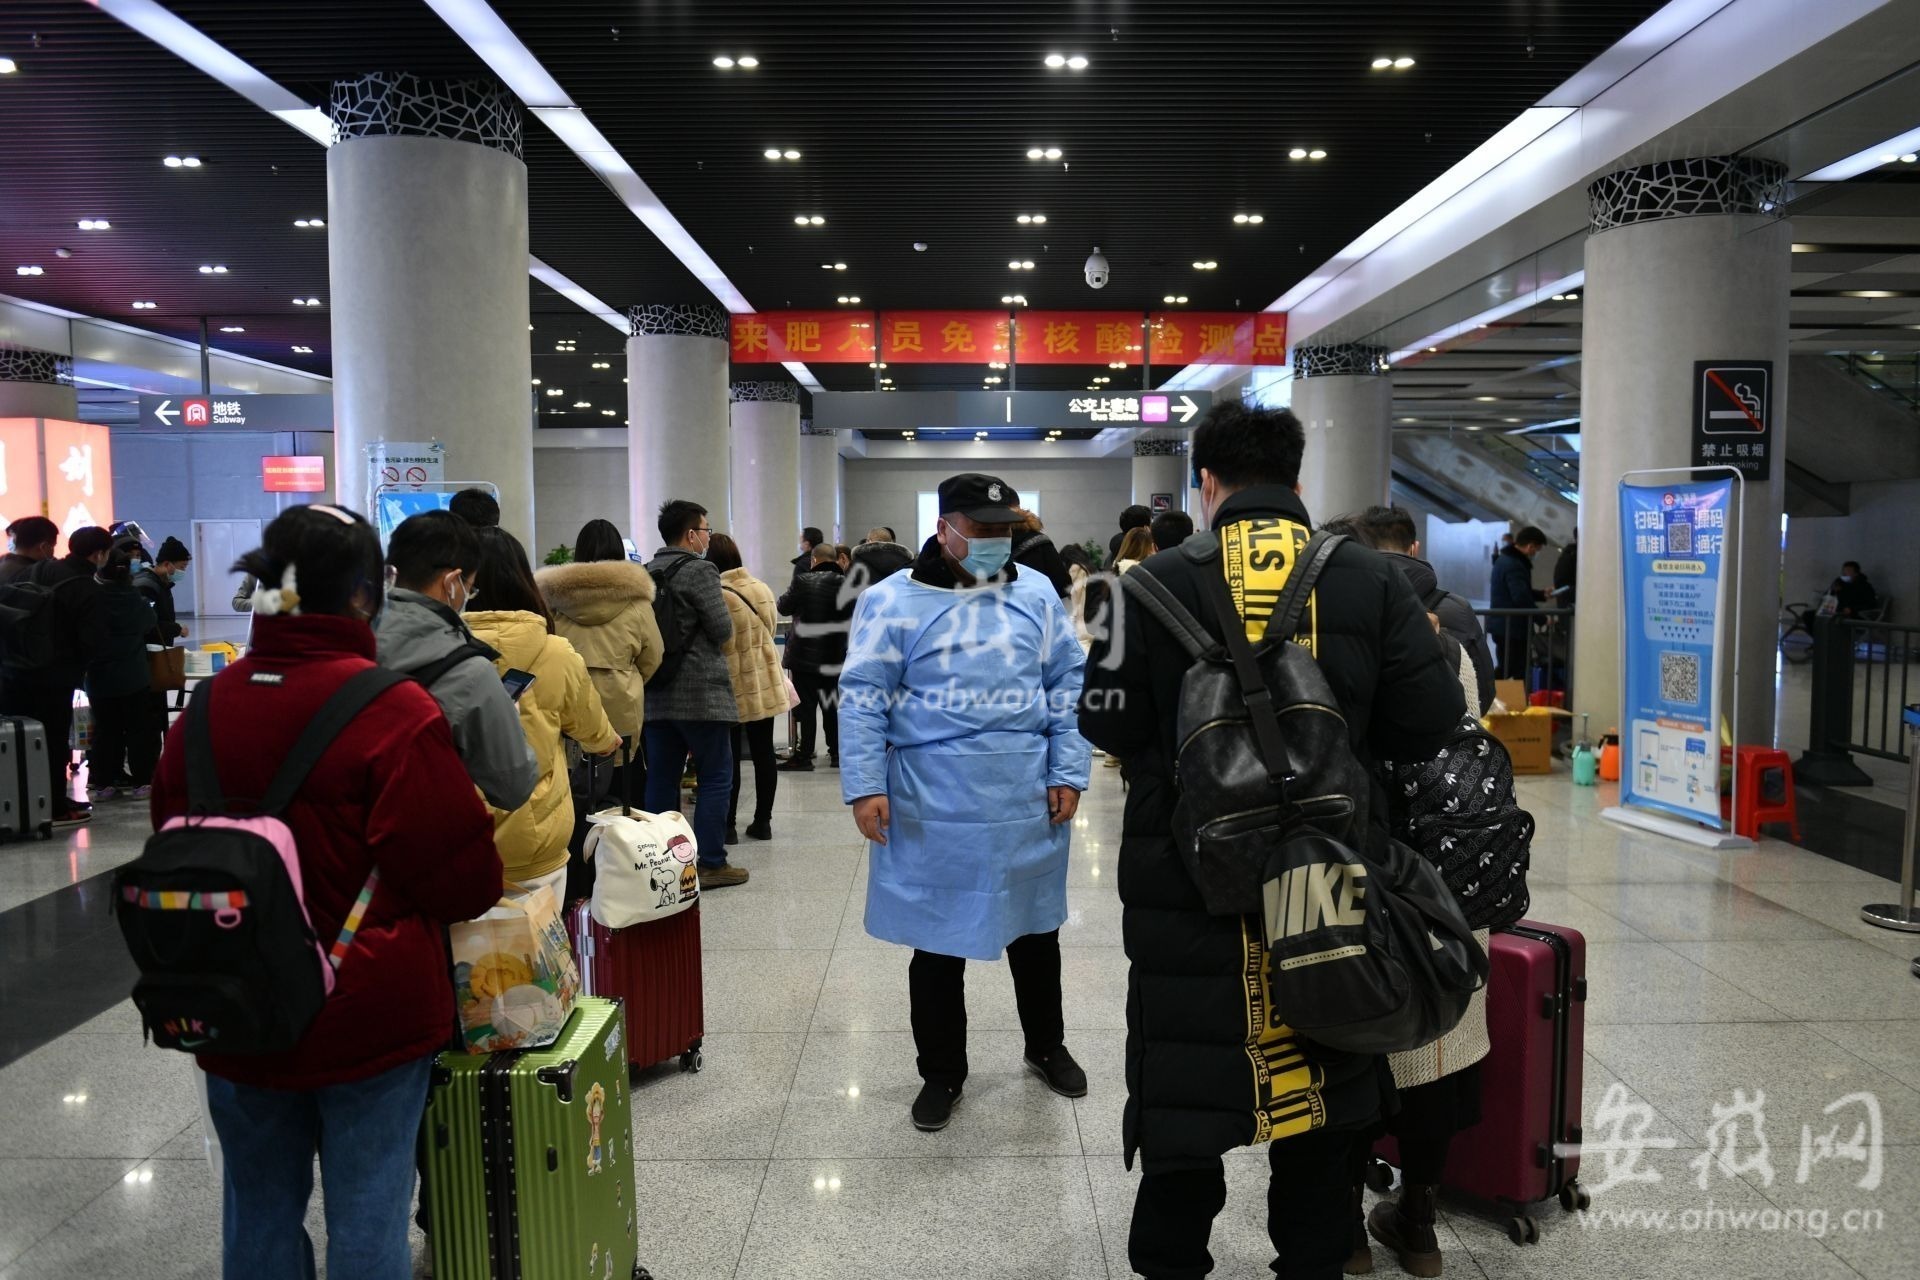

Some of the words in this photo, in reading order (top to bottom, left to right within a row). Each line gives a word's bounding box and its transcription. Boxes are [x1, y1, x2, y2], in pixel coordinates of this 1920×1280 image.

[734, 320, 1285, 356] 来肥人员免费核酸检测点
[213, 401, 242, 416] 地铁
[213, 415, 246, 425] Subway
[1702, 443, 1764, 457] 禁止吸烟
[1228, 543, 1243, 576] THREE
[1230, 579, 1245, 624] STRIP
[649, 855, 671, 868] Peanut
[1263, 862, 1367, 949] NIKE
[1248, 941, 1261, 972] WITH
[1247, 973, 1262, 997] THE
[1306, 1082, 1322, 1126] STRIPS
